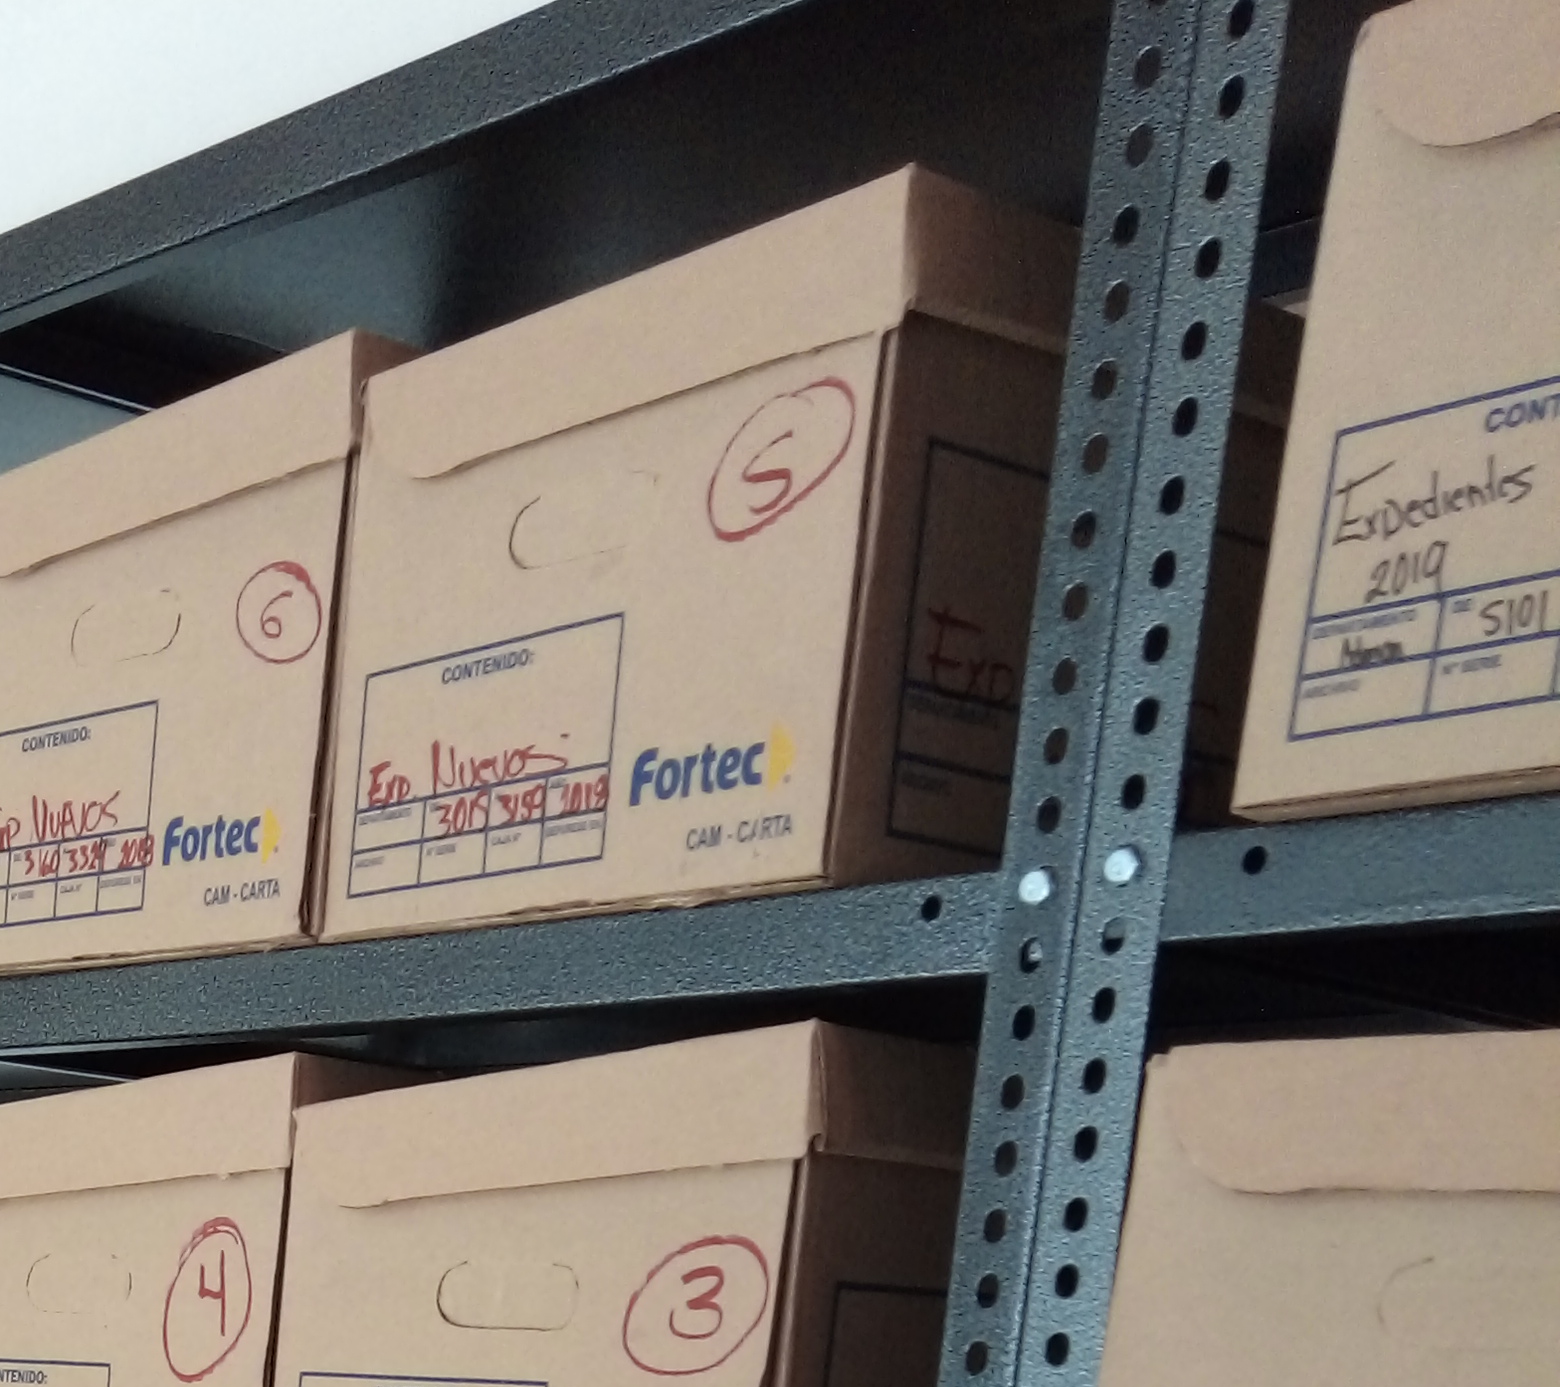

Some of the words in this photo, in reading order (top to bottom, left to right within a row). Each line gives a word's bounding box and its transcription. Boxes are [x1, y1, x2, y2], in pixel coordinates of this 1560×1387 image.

[441, 649, 535, 684] CONTENIDO:
[22, 727, 91, 752] CONTENIDO:
[630, 741, 763, 806] Fortec
[162, 814, 262, 866] Fortec
[686, 824, 725, 851] CAM
[740, 814, 793, 844] CARTA
[204, 887, 230, 907] CAM
[241, 879, 281, 901] CARTA
